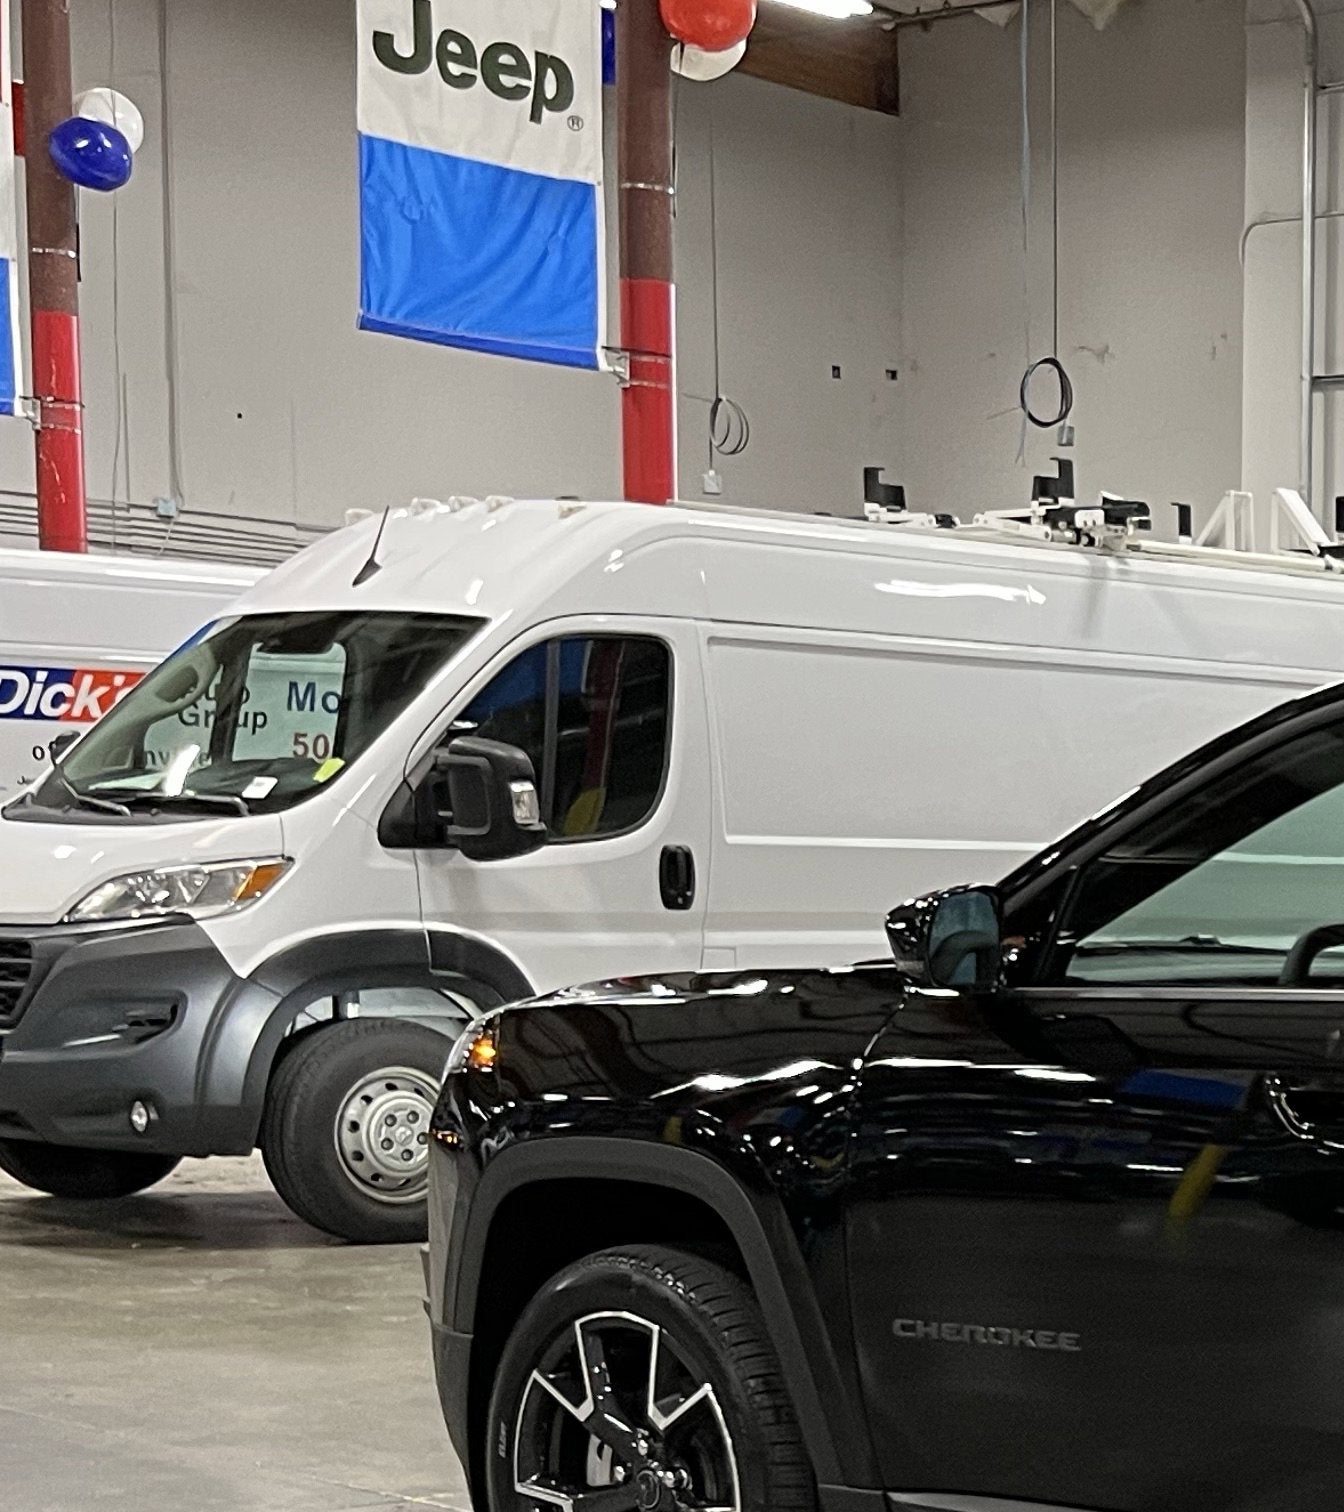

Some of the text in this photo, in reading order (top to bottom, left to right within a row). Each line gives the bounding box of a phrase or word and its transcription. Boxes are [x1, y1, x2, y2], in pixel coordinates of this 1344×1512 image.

[373, 0, 574, 124] Jeep
[0, 670, 133, 718] Dick'
[178, 701, 268, 735] Grup
[892, 1318, 1081, 1351] CHEROKEE
